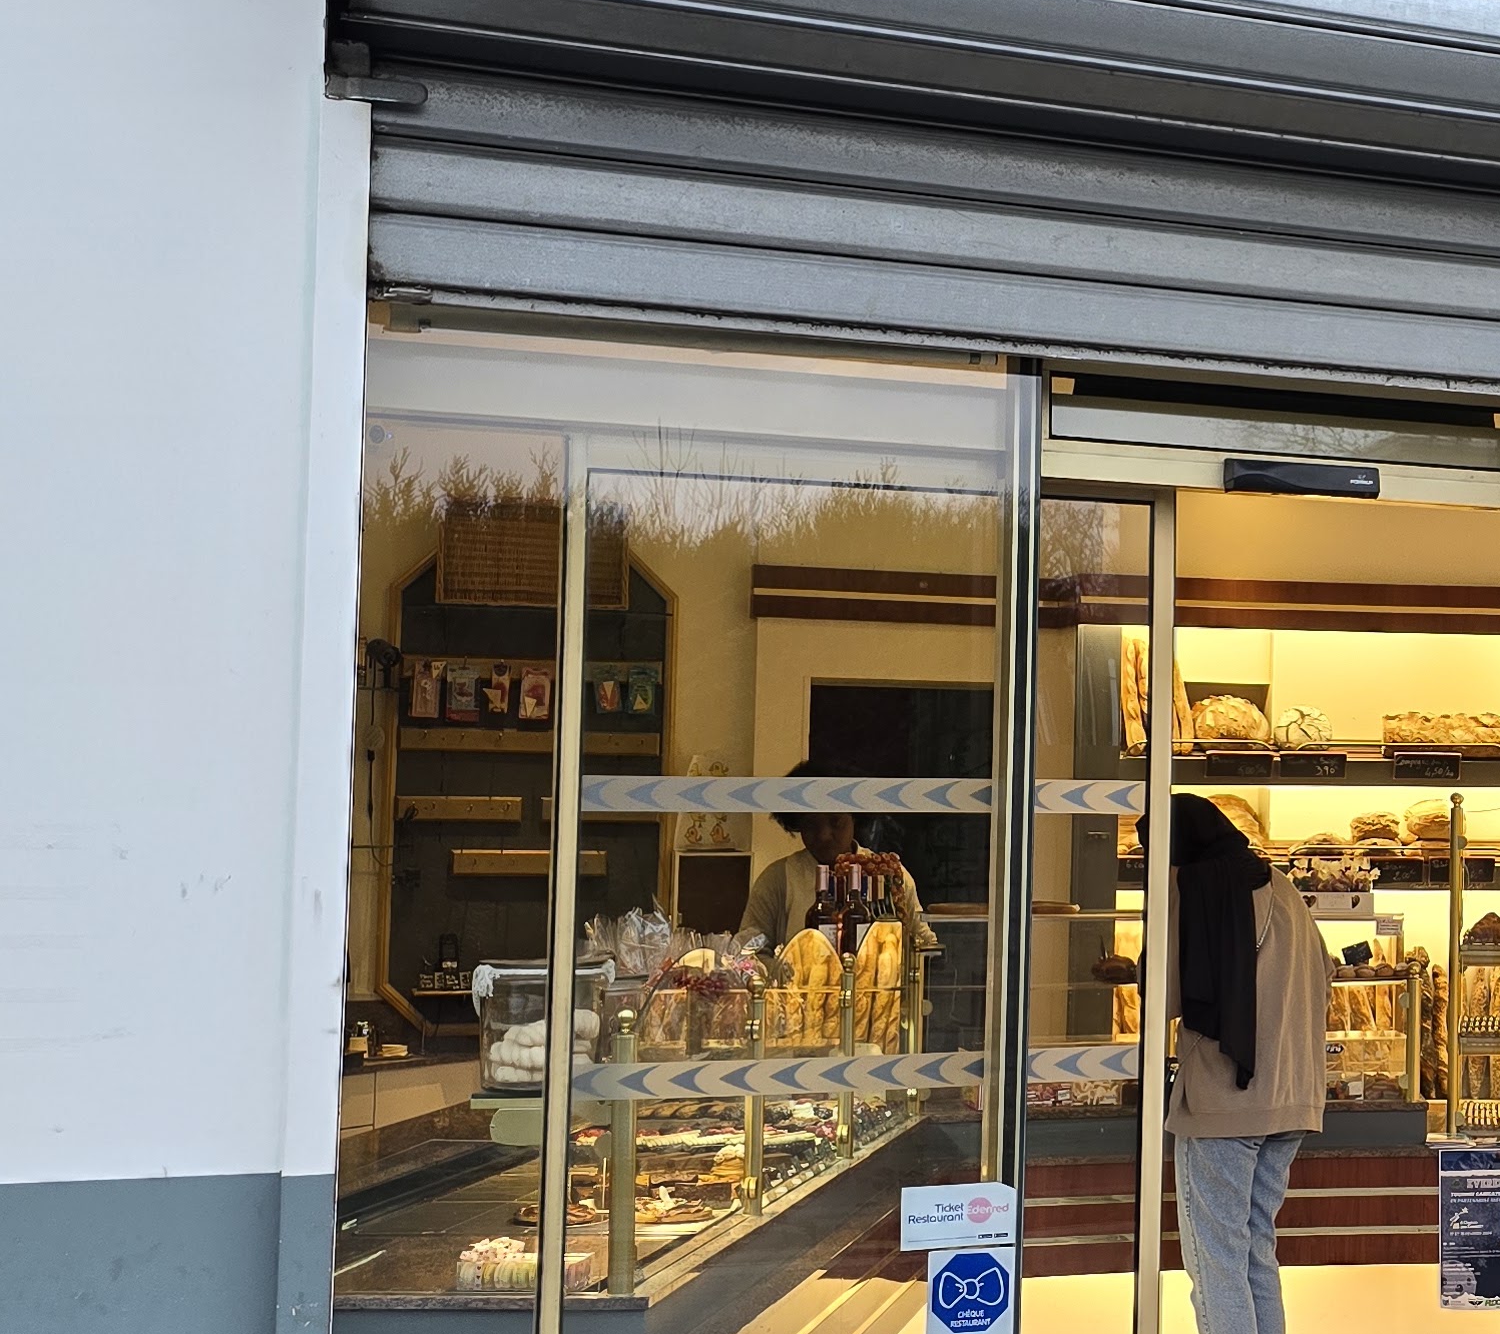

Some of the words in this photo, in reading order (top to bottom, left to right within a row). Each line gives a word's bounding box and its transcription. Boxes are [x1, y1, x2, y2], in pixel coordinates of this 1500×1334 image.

[935, 1202, 964, 1213] Ticket
[967, 1203, 1009, 1214] Edenred
[908, 1213, 964, 1224] Restaurant
[950, 1318, 991, 1327] RESTAURANT
